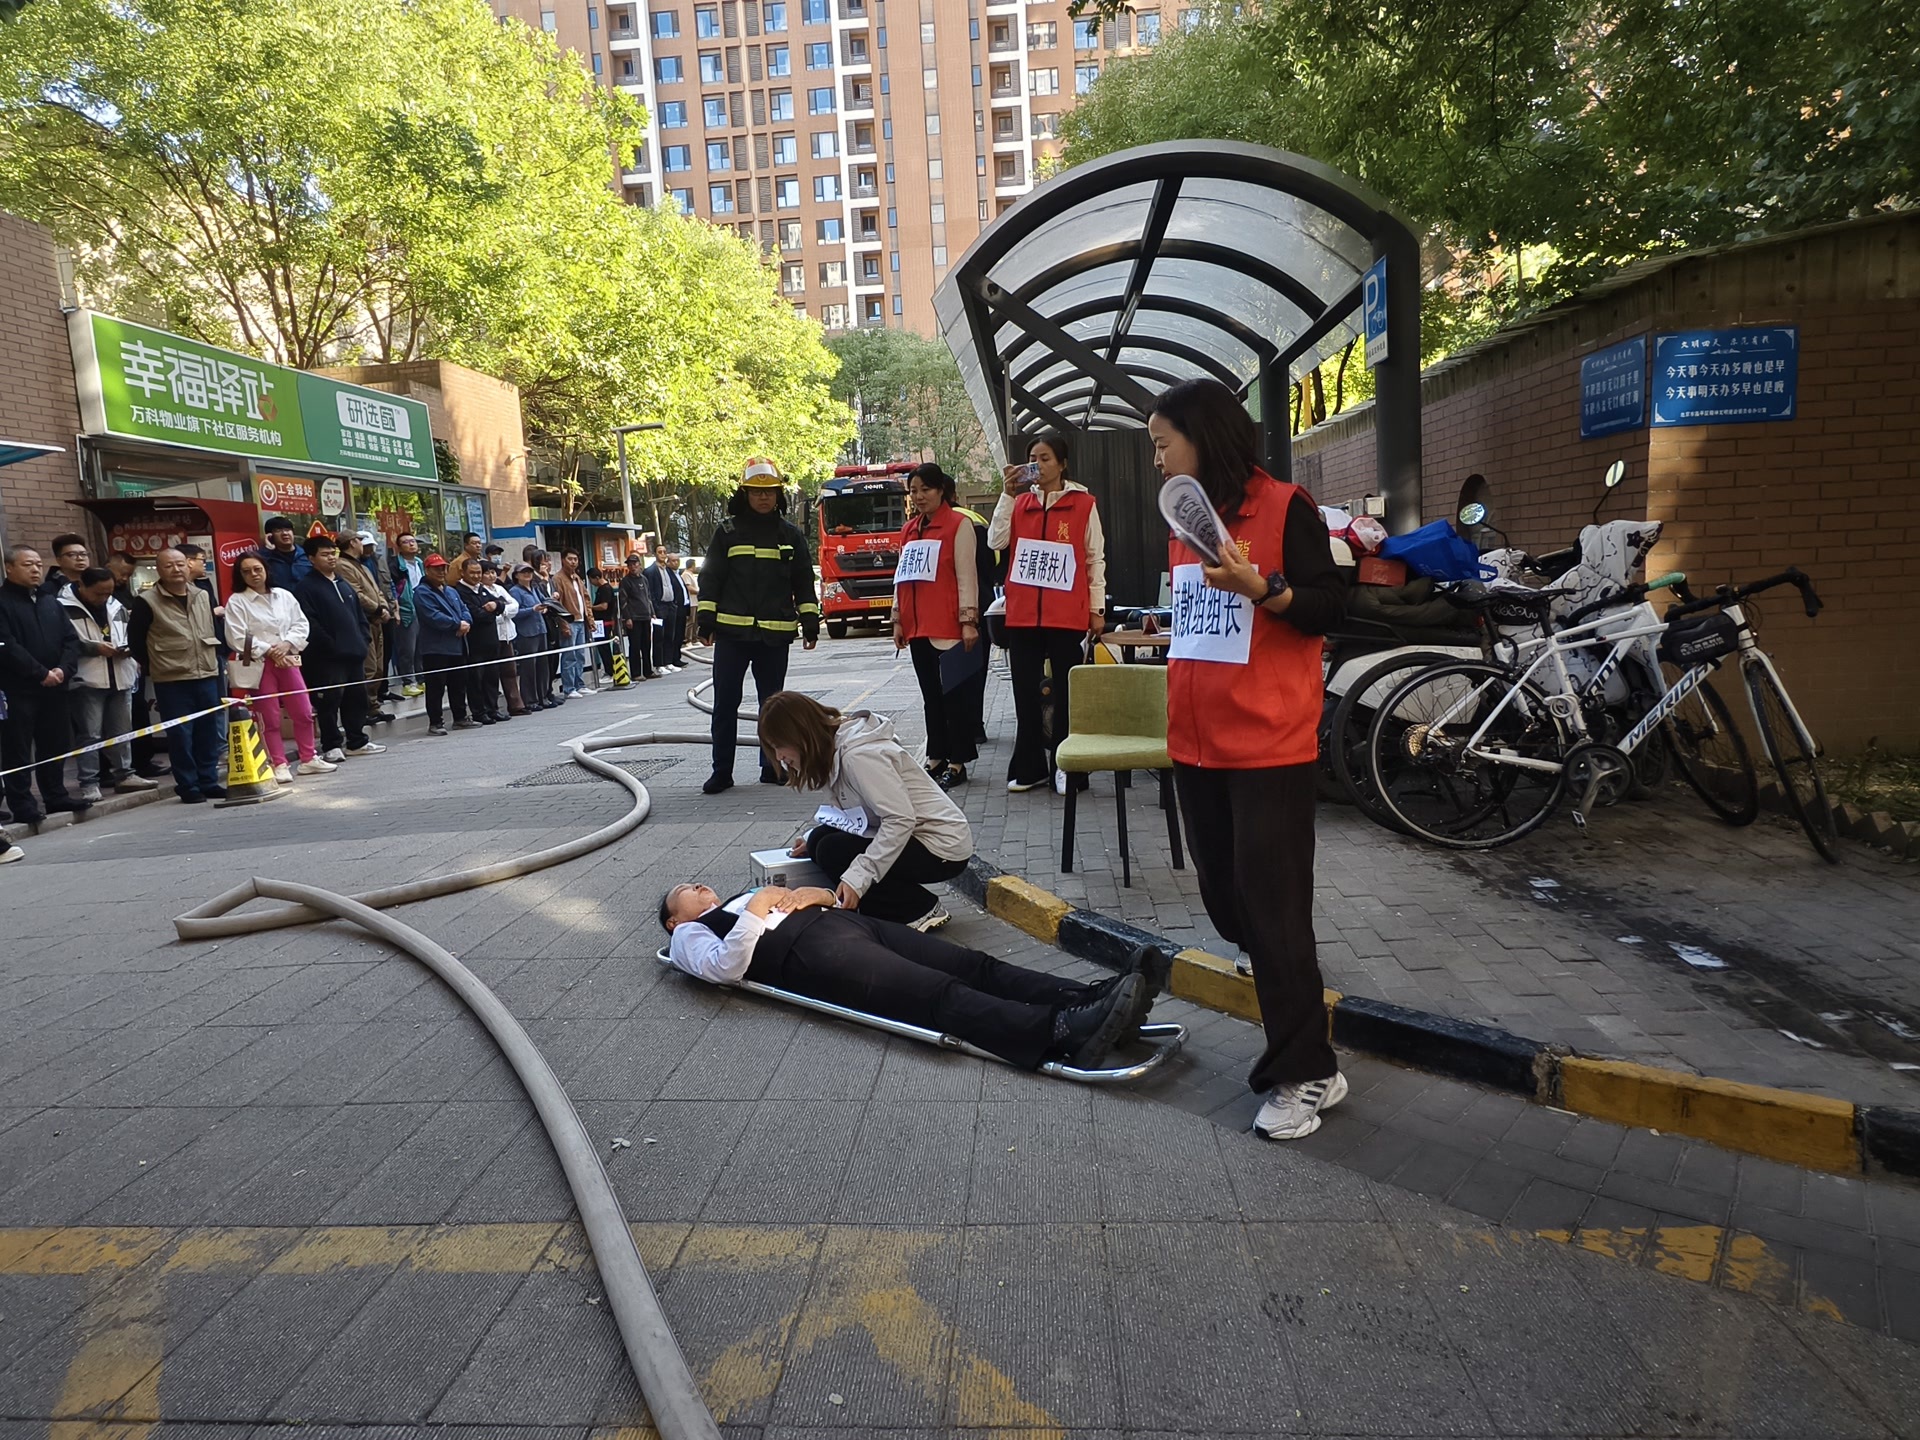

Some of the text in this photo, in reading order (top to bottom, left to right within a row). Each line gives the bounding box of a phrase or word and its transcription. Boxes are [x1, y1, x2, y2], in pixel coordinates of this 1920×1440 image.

[120, 340, 277, 421] 幸福驿站
[1666, 359, 1785, 379] 今天事今天办多晚也是早
[1665, 380, 1785, 400] 今天事明天办多早也是晚
[130, 405, 282, 447] 万科物业旗下社区服务机构
[346, 397, 396, 432] 研选家
[277, 482, 313, 497] 工会驿站
[1018, 548, 1068, 584] 专属帮扶人
[1627, 661, 1709, 749] MERIDA
[232, 725, 245, 773] 装修找物业
